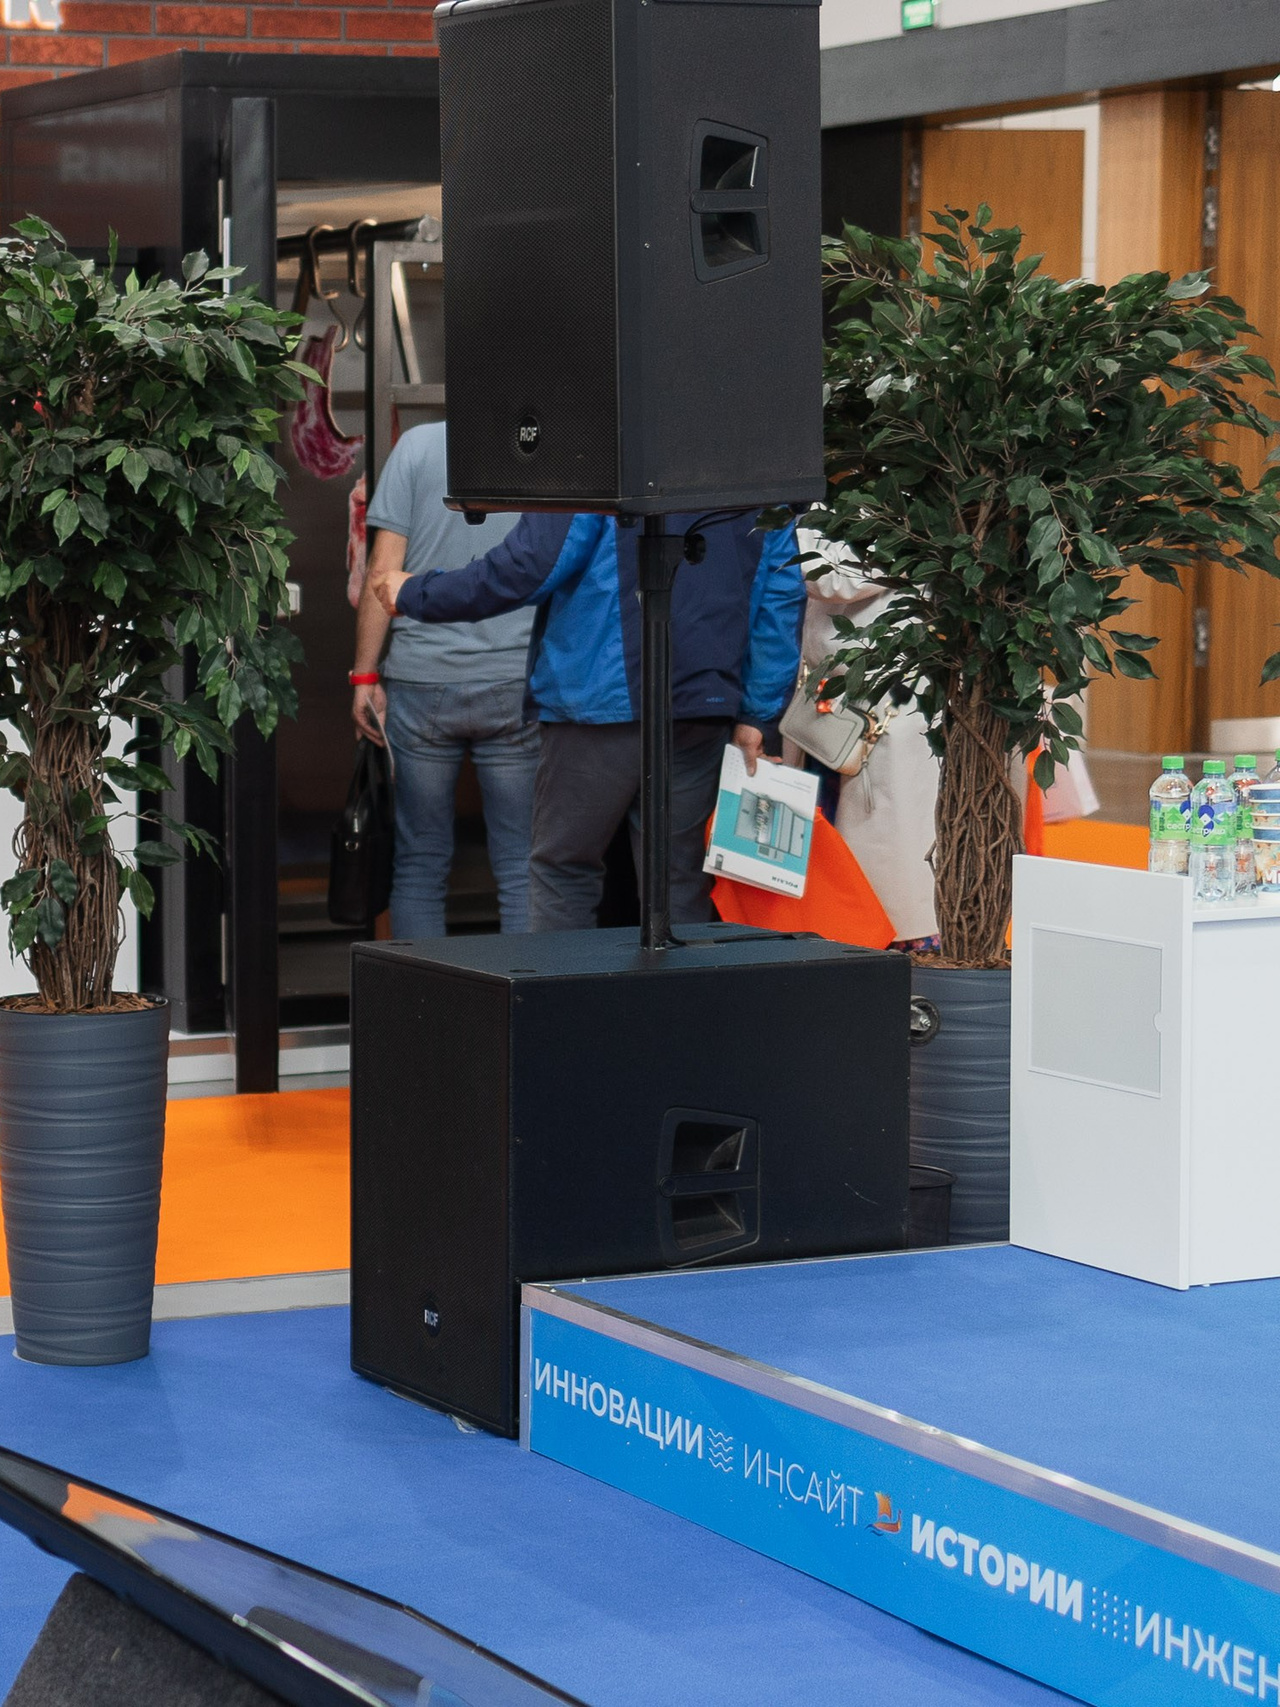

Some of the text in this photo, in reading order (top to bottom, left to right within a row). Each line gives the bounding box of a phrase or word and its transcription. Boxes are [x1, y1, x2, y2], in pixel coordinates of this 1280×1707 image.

[519, 426, 538, 442] RCF
[424, 1308, 439, 1327] RCF
[534, 1357, 1280, 1707] ИННОВАЦИИ ИНСАЙТ ИСТОРИИ ИНЖЕН
